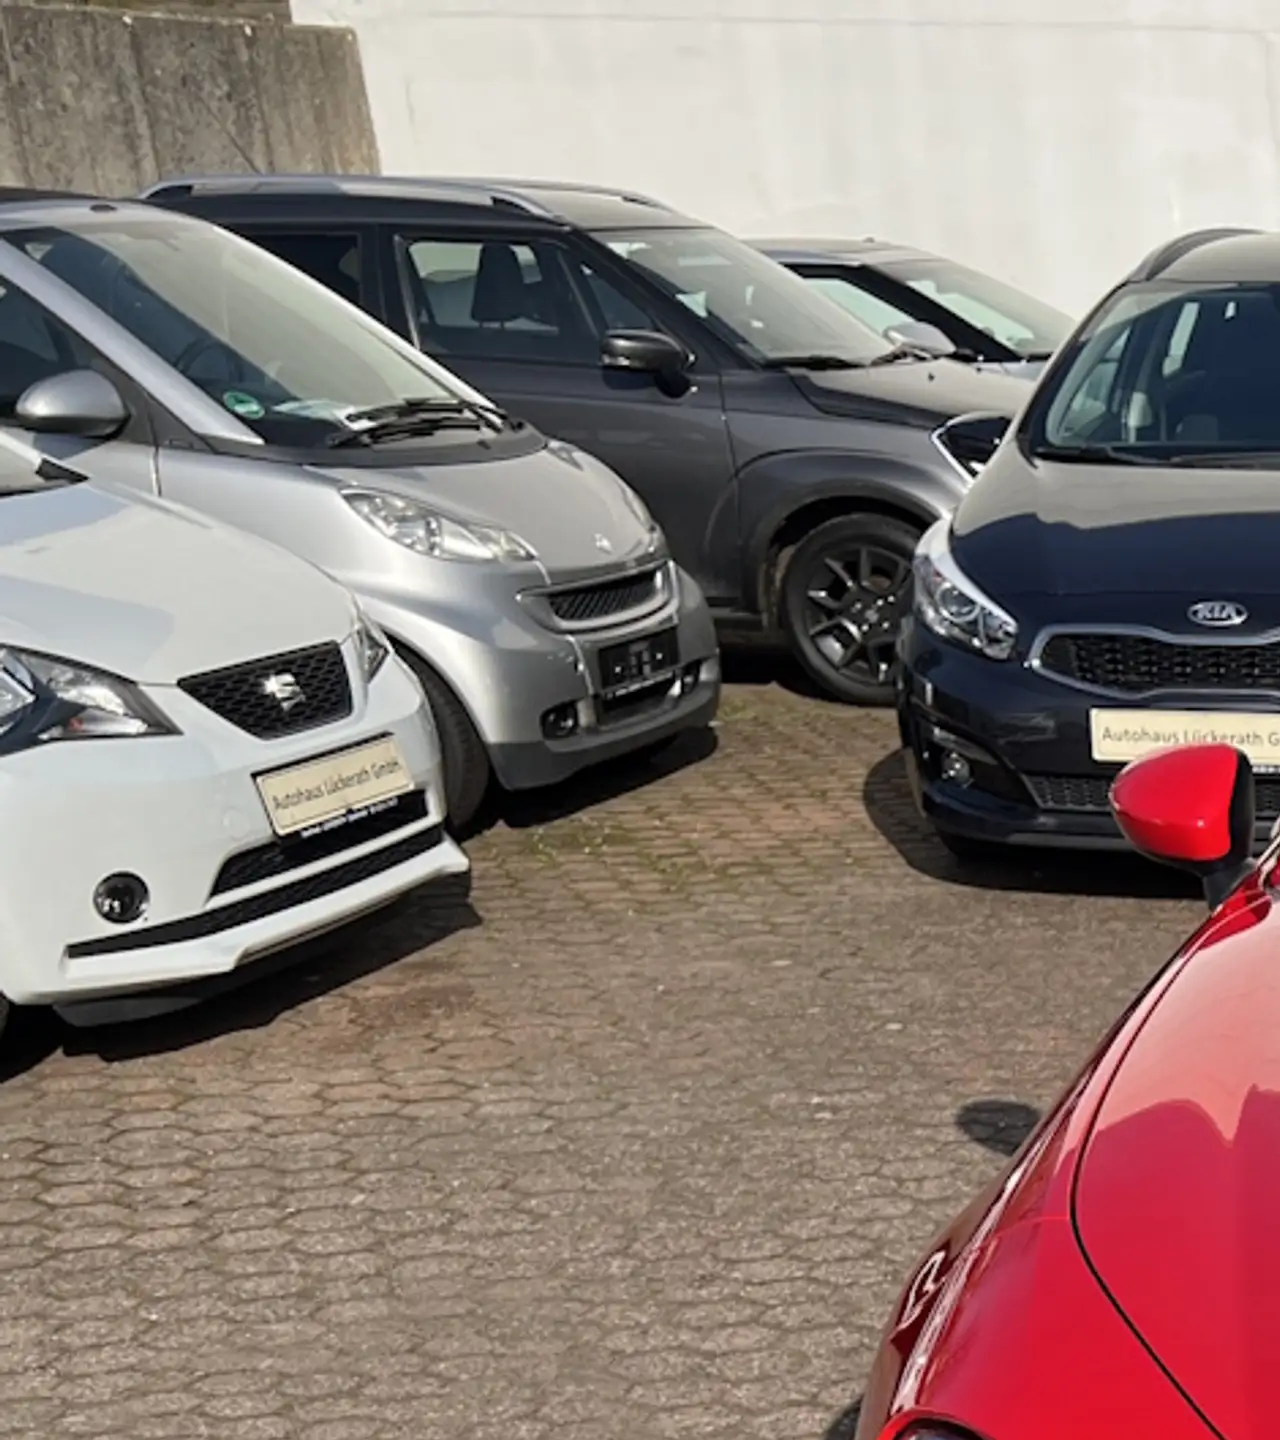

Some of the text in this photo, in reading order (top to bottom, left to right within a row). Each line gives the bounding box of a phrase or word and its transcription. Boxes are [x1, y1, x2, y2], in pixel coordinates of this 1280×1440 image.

[1195, 602, 1241, 621] KIA
[1101, 725, 1180, 745] Autohaus
[1183, 728, 1264, 746] Lückerath
